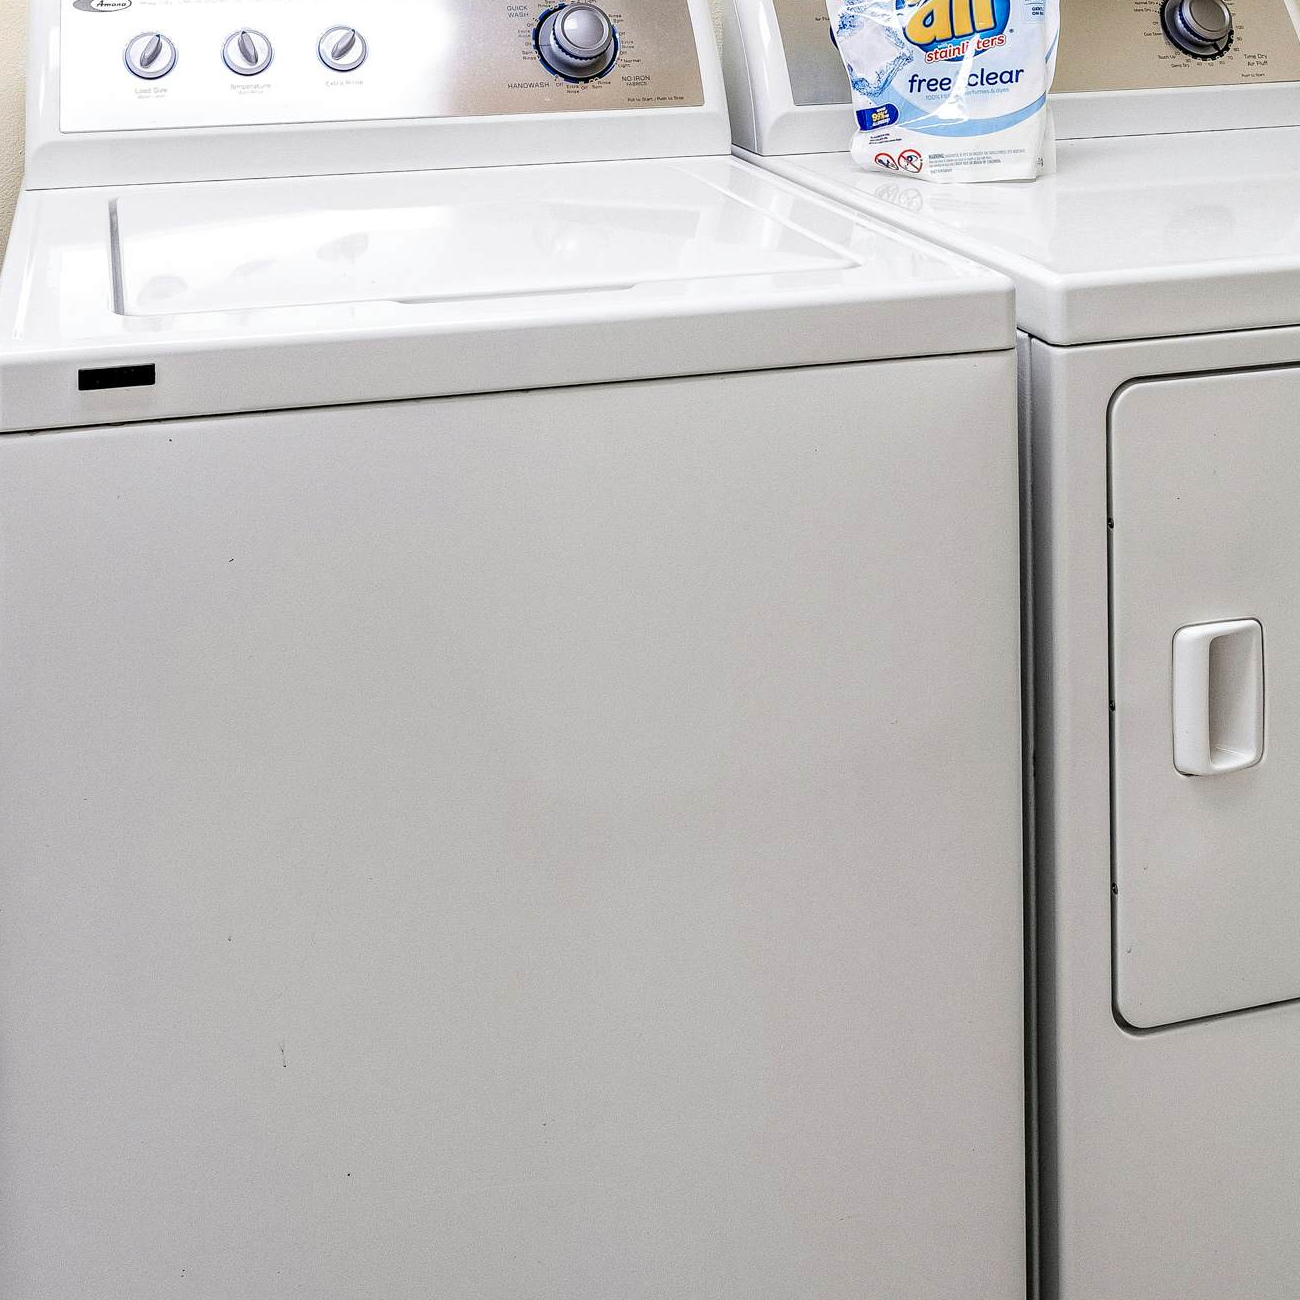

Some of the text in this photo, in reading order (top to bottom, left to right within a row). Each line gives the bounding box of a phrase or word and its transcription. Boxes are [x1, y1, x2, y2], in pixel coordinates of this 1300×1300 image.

[96, 0, 127, 8] Amana
[926, 35, 1006, 63] stainliters
[908, 67, 1024, 93] free clear
[230, 83, 272, 91] Temperature
[965, 88, 990, 96] erfumes
